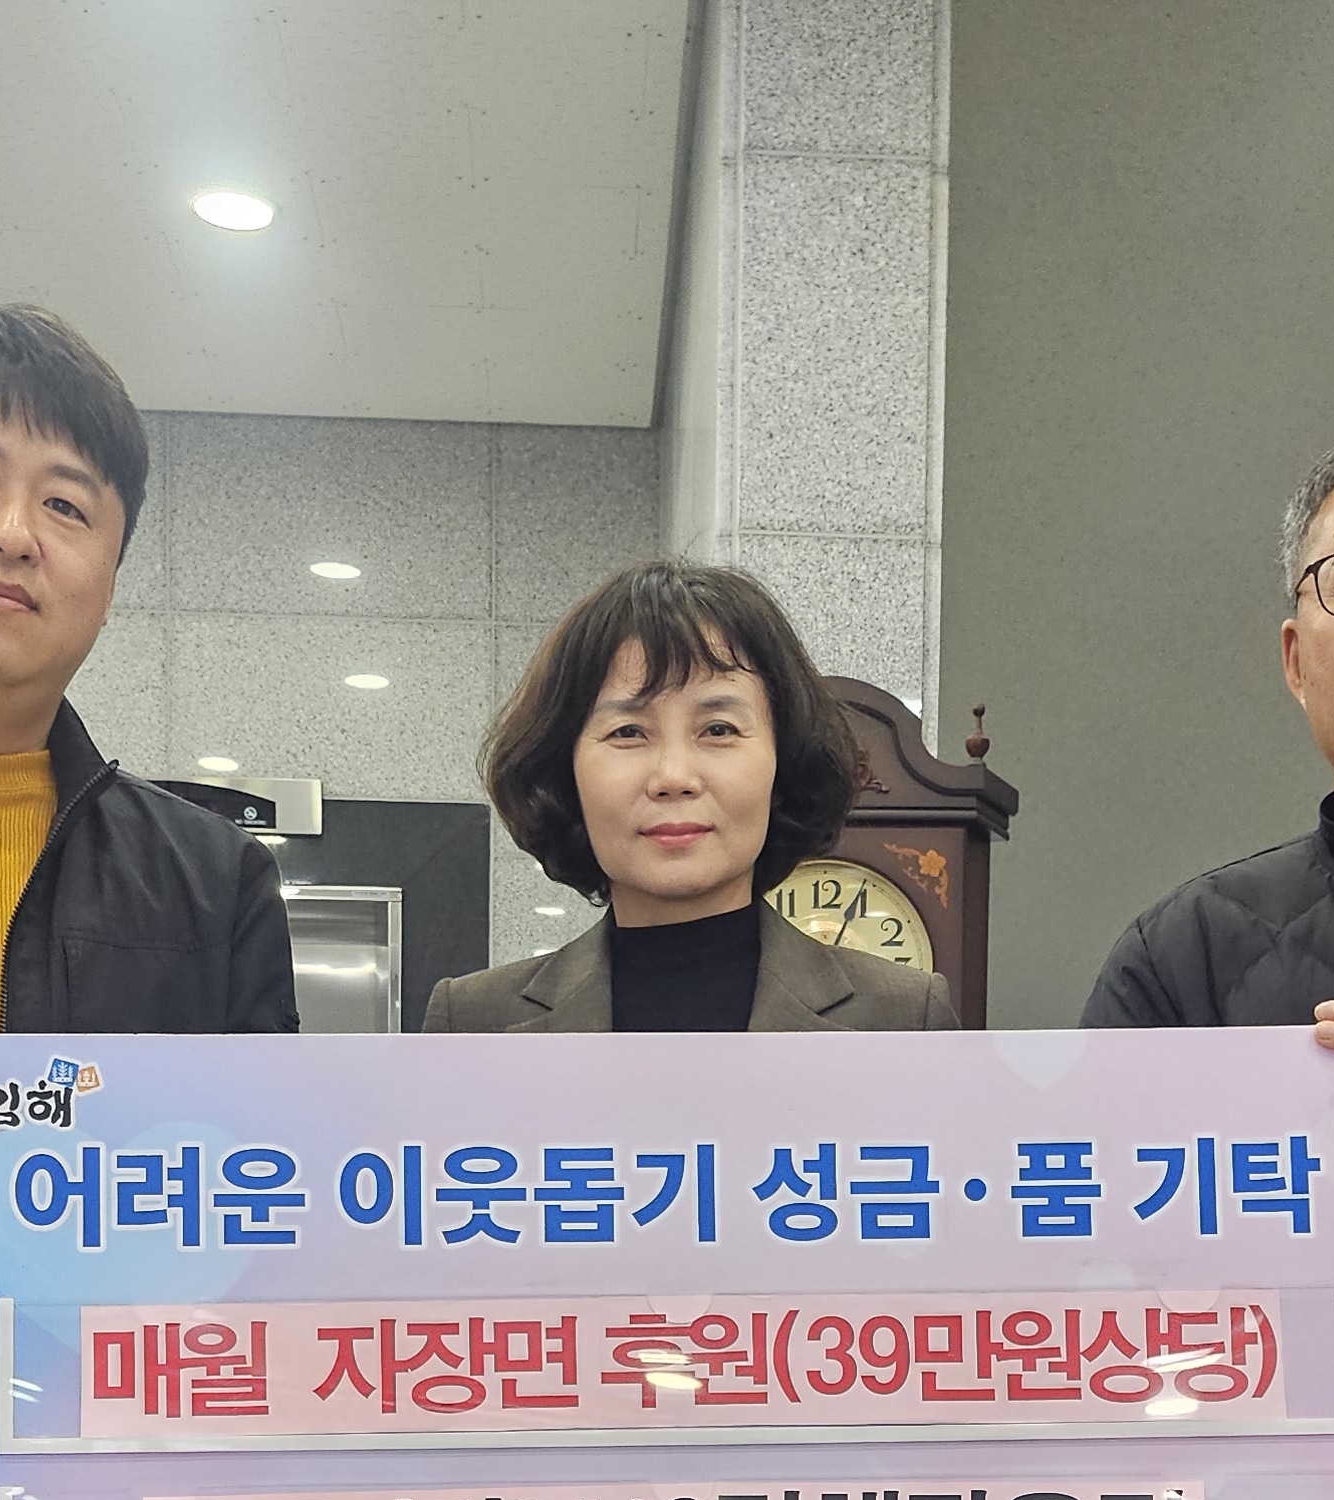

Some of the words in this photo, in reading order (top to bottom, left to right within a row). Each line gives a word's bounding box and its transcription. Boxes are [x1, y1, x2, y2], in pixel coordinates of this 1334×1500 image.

[812, 880, 843, 909] 12
[880, 918, 905, 947] 2
[15, 1146, 306, 1247] 어려운
[339, 1143, 717, 1246] 이웃돕기
[1132, 1136, 1322, 1236] 기탁
[92, 1320, 270, 1418] 매월
[313, 1315, 579, 1414] 자장면
[600, 1304, 1278, 1410] 후원(39만원상당)
